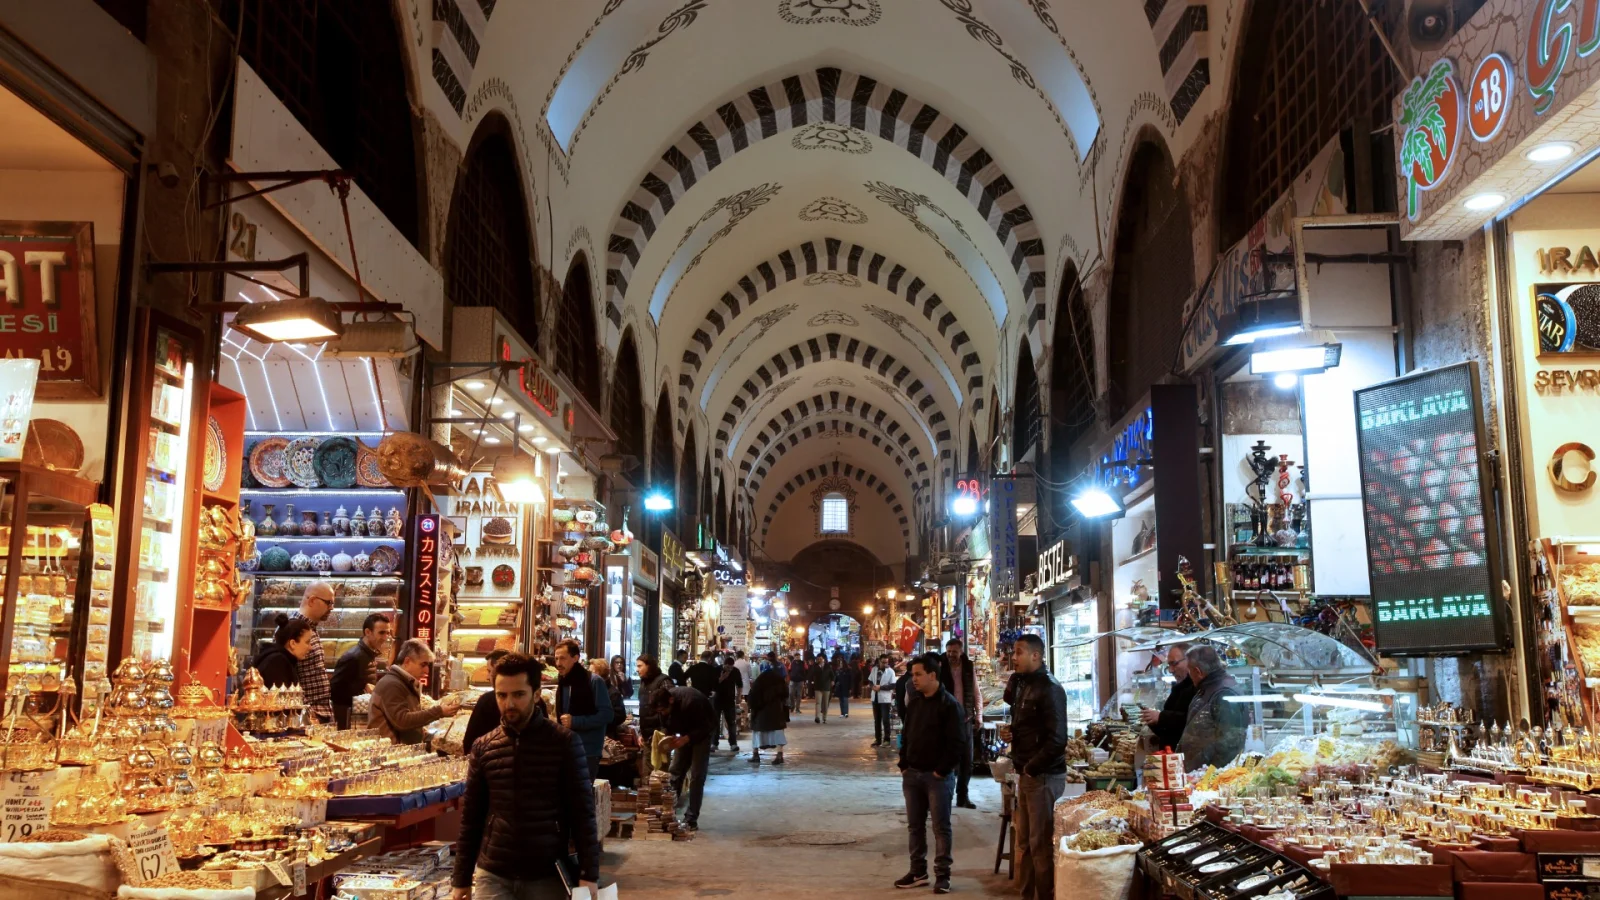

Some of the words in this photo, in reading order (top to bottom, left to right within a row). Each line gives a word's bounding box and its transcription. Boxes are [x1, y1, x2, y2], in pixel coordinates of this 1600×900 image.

[1481, 68, 1502, 121] 18
[230, 212, 258, 261] 21
[1537, 245, 1600, 274] IRA
[41, 346, 72, 372] 19
[1536, 370, 1600, 389] SEVR
[1361, 390, 1469, 431] BAKLAVA
[1548, 442, 1598, 493] C
[456, 500, 519, 514] IRANIAN
[423, 521, 433, 529] 21
[1038, 540, 1073, 593] BESTEL
[1377, 594, 1491, 622] BAKLAVA
